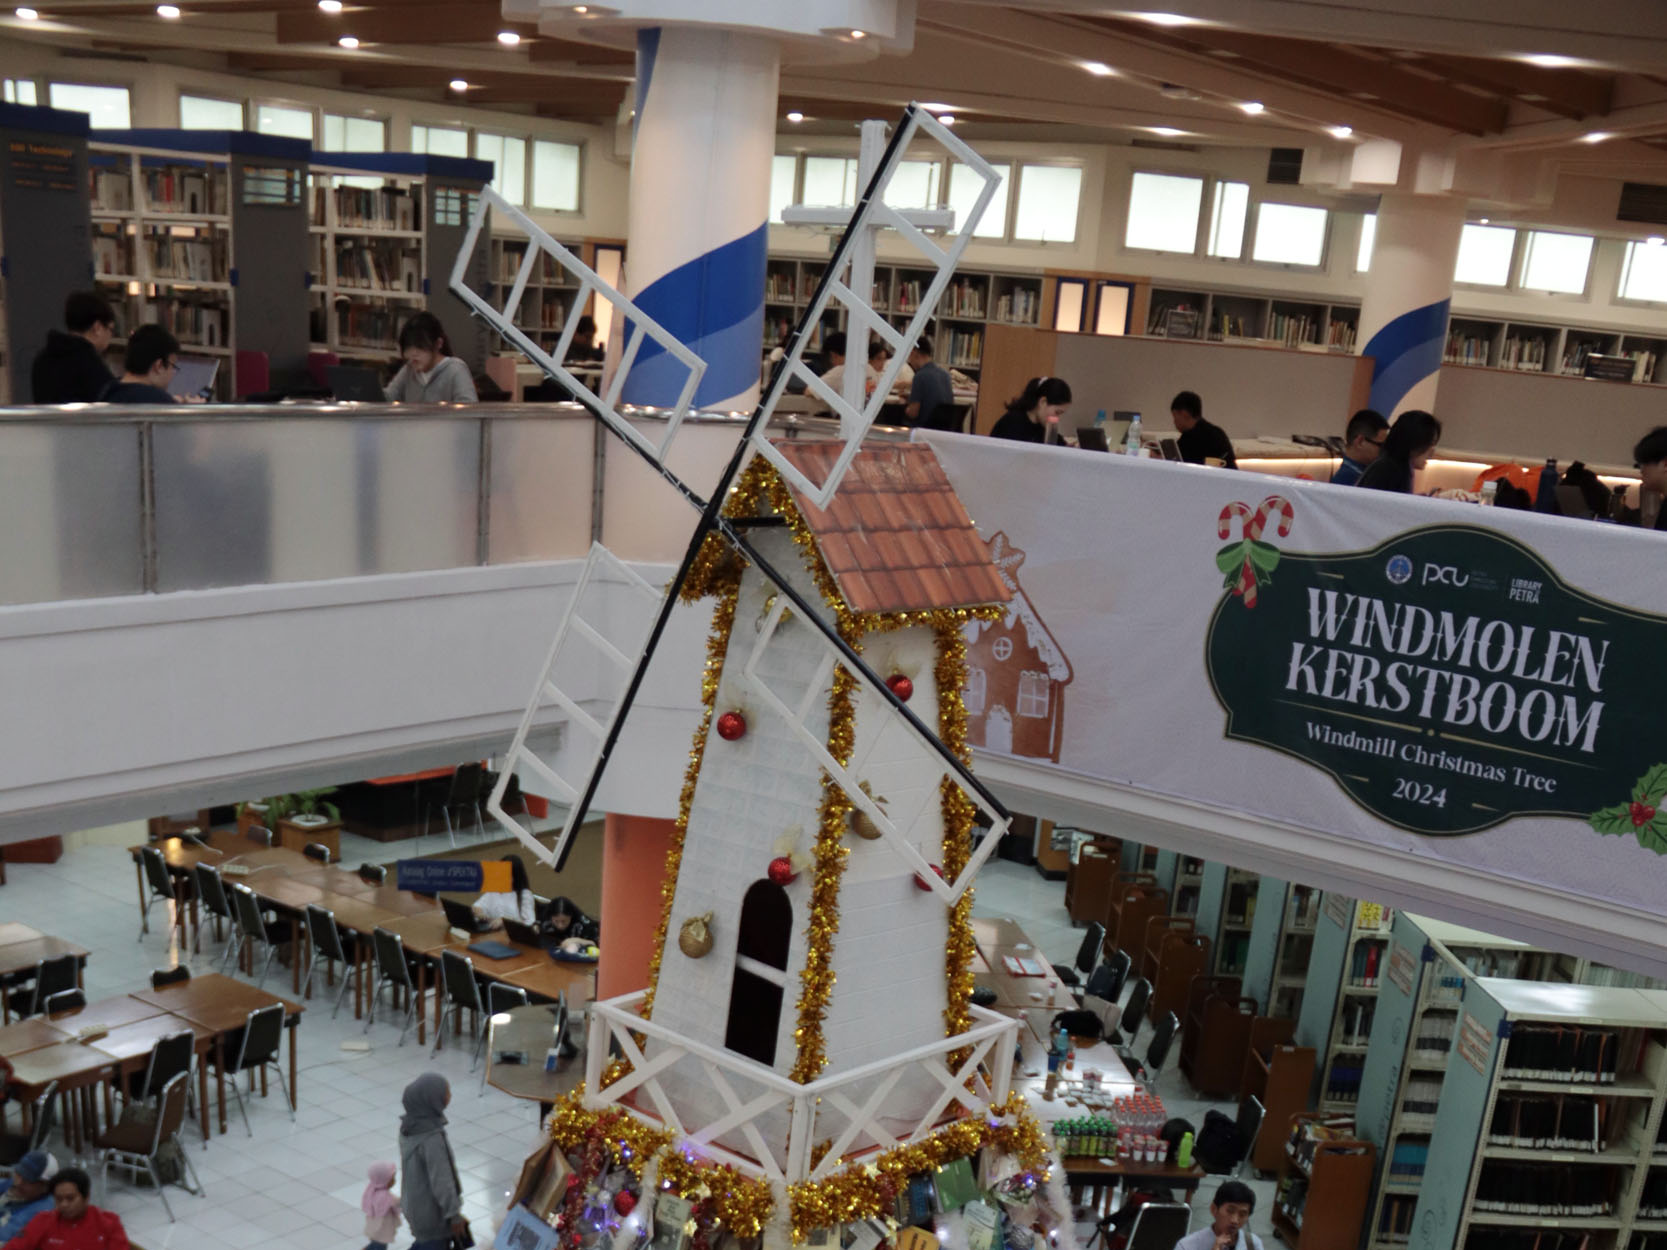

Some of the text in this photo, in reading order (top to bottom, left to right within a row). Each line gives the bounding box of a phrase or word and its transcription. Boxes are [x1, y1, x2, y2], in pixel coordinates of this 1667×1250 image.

[1508, 588, 1541, 605] PETRA
[1511, 578, 1543, 592] LIBRARY
[1307, 587, 1610, 693] WINDMOLEN
[1285, 641, 1605, 754] KERSTBOOM
[1306, 721, 1558, 794] Windmill Christmas Tree
[1392, 778, 1449, 808] 2024
